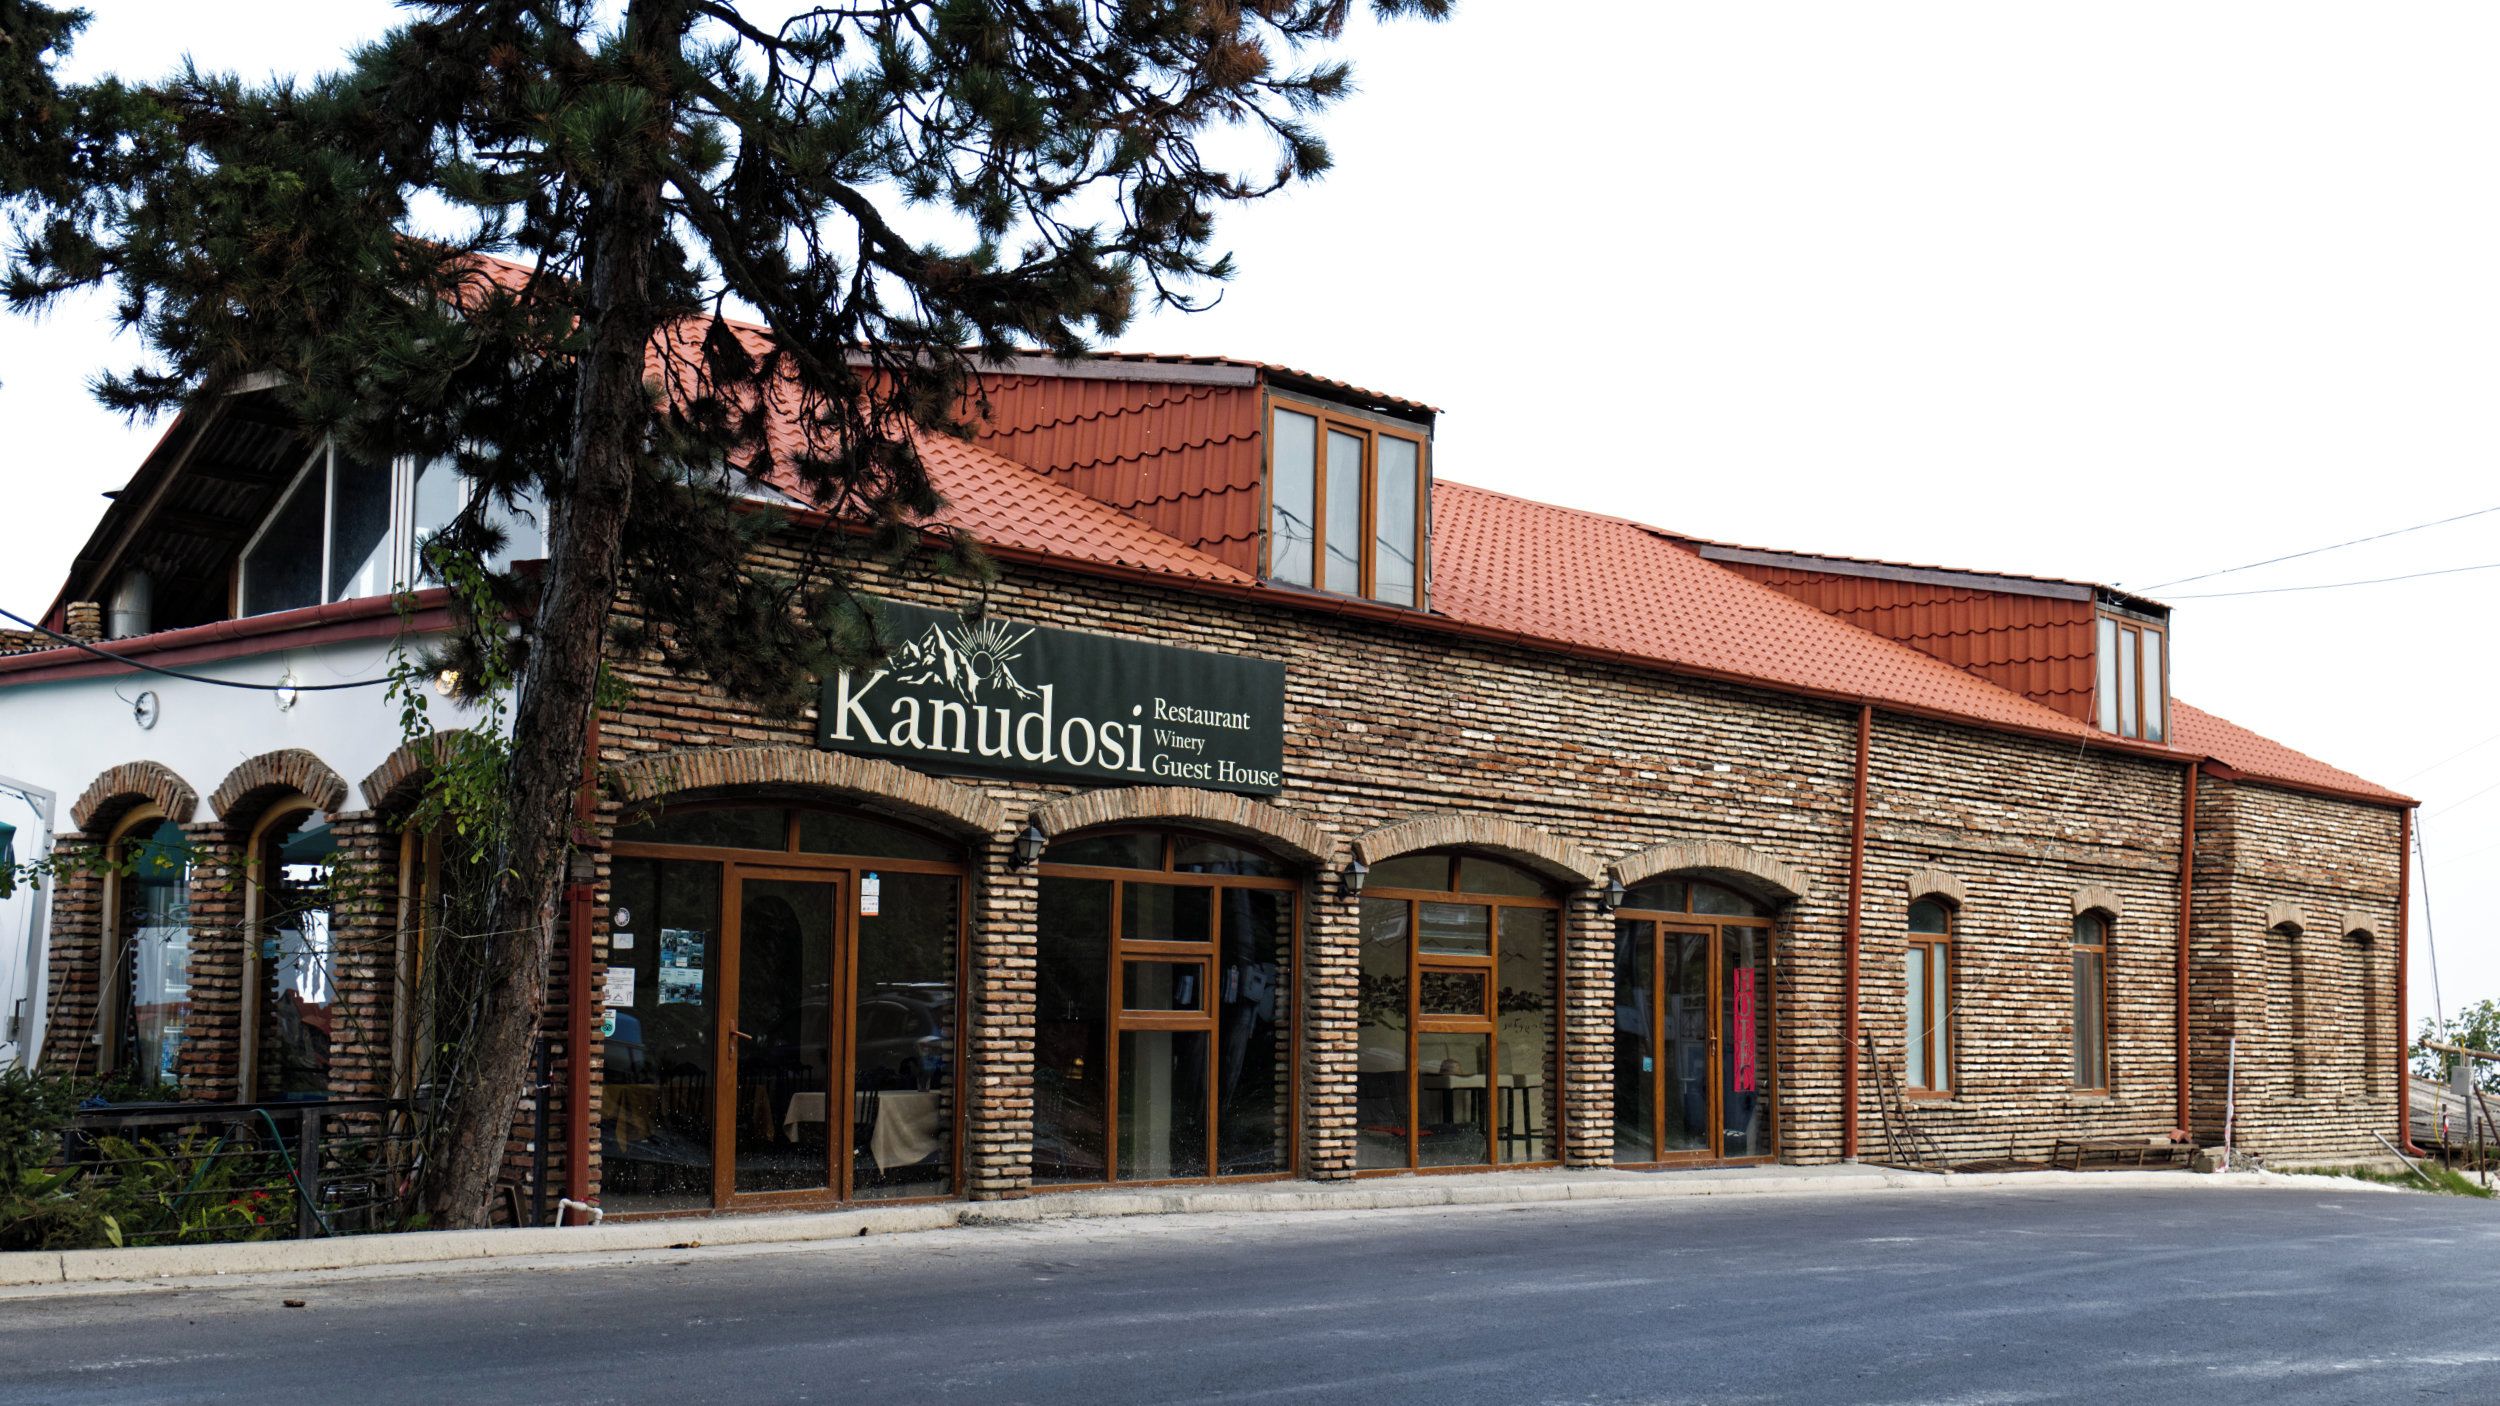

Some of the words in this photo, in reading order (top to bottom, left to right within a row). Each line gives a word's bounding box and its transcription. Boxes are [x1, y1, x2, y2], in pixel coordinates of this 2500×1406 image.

[830, 668, 1146, 773] Kanudosi
[1153, 697, 1251, 730] Restaurant
[1153, 728, 1206, 756] Winery
[1152, 753, 1213, 780] Guest
[1217, 759, 1279, 787] House
